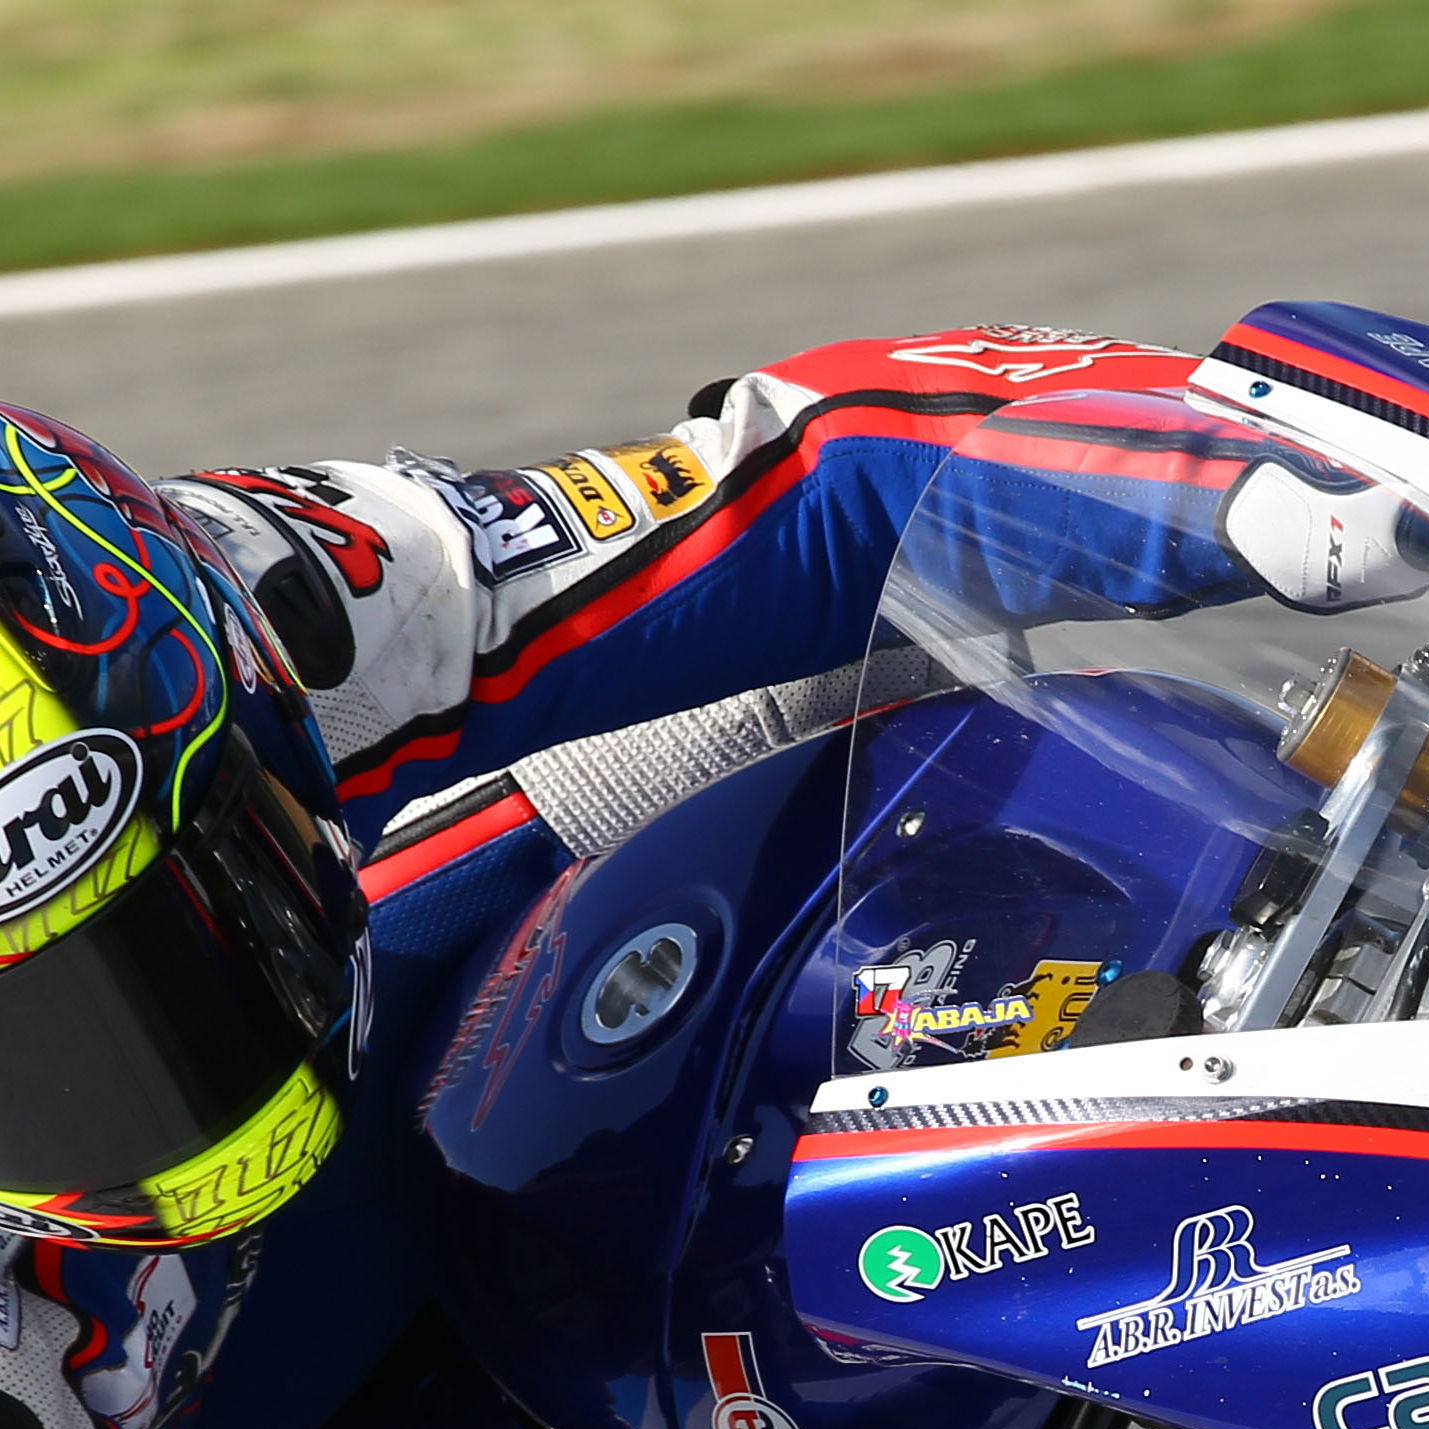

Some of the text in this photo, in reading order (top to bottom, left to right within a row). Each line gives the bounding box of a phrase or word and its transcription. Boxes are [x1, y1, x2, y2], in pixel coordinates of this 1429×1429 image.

[0, 741, 112, 882] rai
[851, 964, 911, 1017] 17
[936, 1191, 1096, 1281] KAPE
[1183, 1265, 1312, 1343] INVEST
